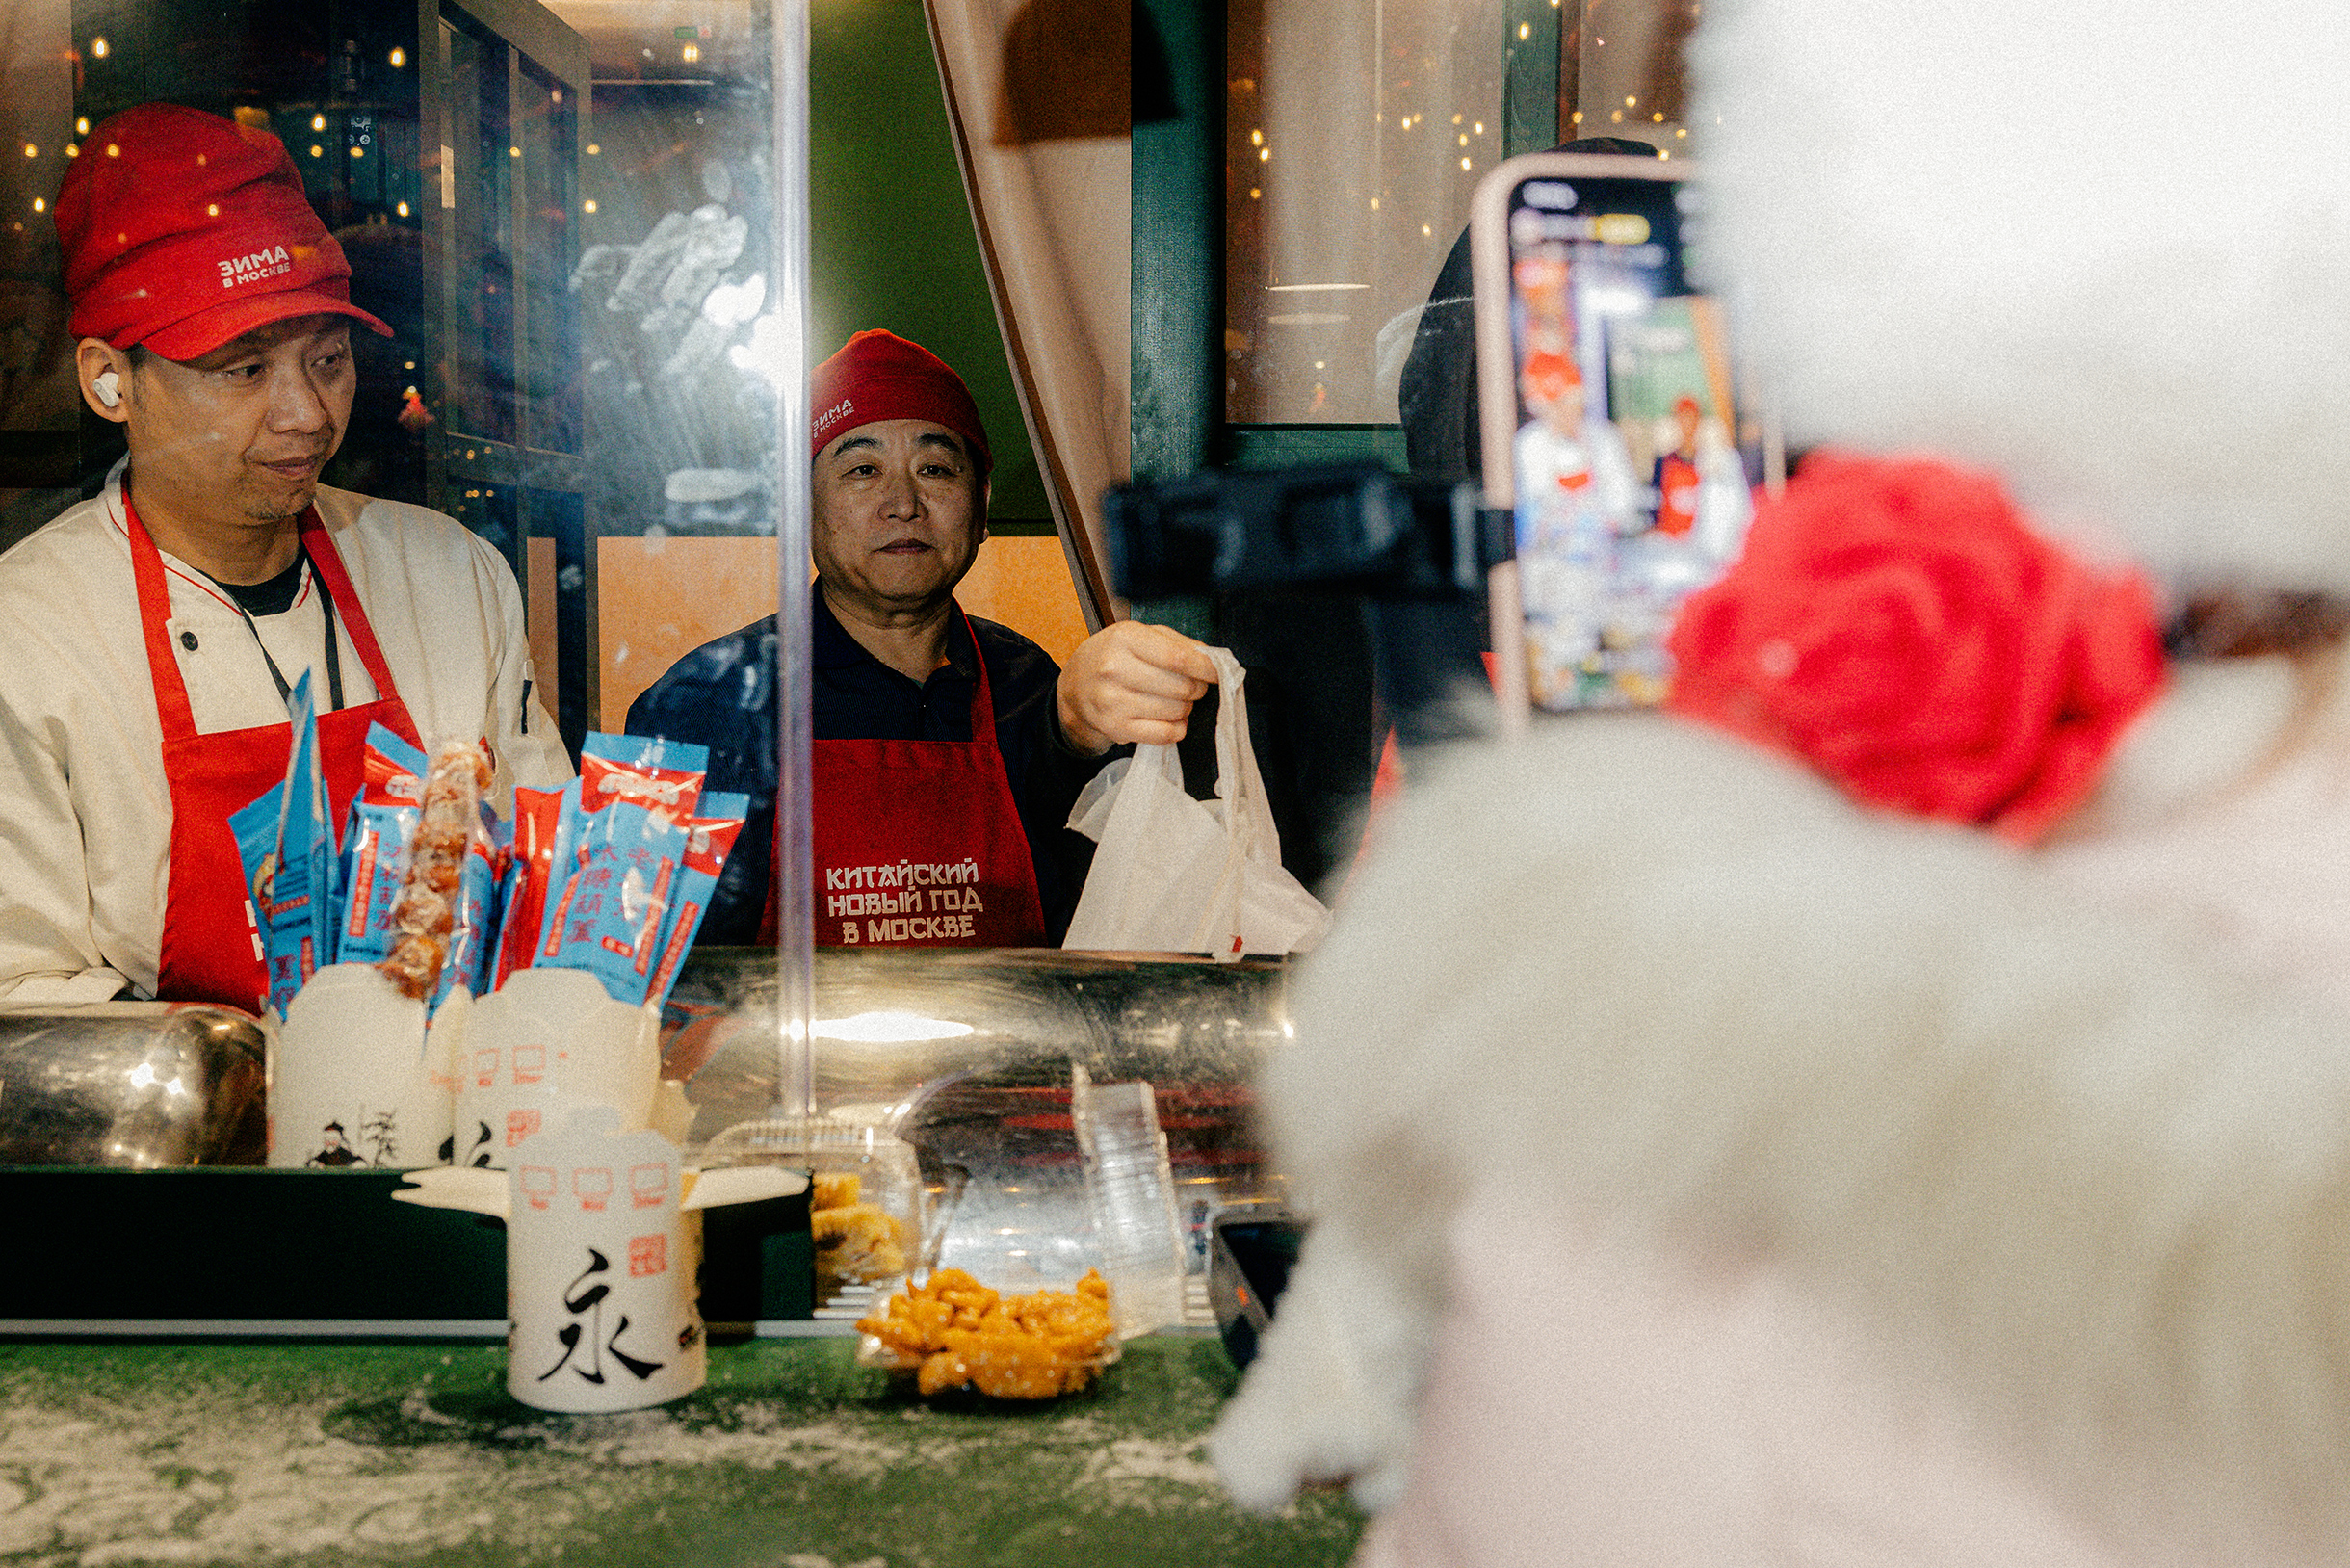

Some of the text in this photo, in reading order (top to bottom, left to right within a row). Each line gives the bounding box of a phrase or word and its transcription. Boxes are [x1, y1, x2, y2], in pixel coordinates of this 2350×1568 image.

[217, 245, 290, 277] ЗИМА
[222, 261, 291, 289] В МОСКВЕ
[812, 399, 853, 432] ЗИМА
[825, 857, 979, 890] КИТАЙСКИЙ
[827, 886, 984, 918] НОВЫЙ ГОД
[842, 914, 977, 944] В МОСКВЕ
[537, 1245, 665, 1385] 永
